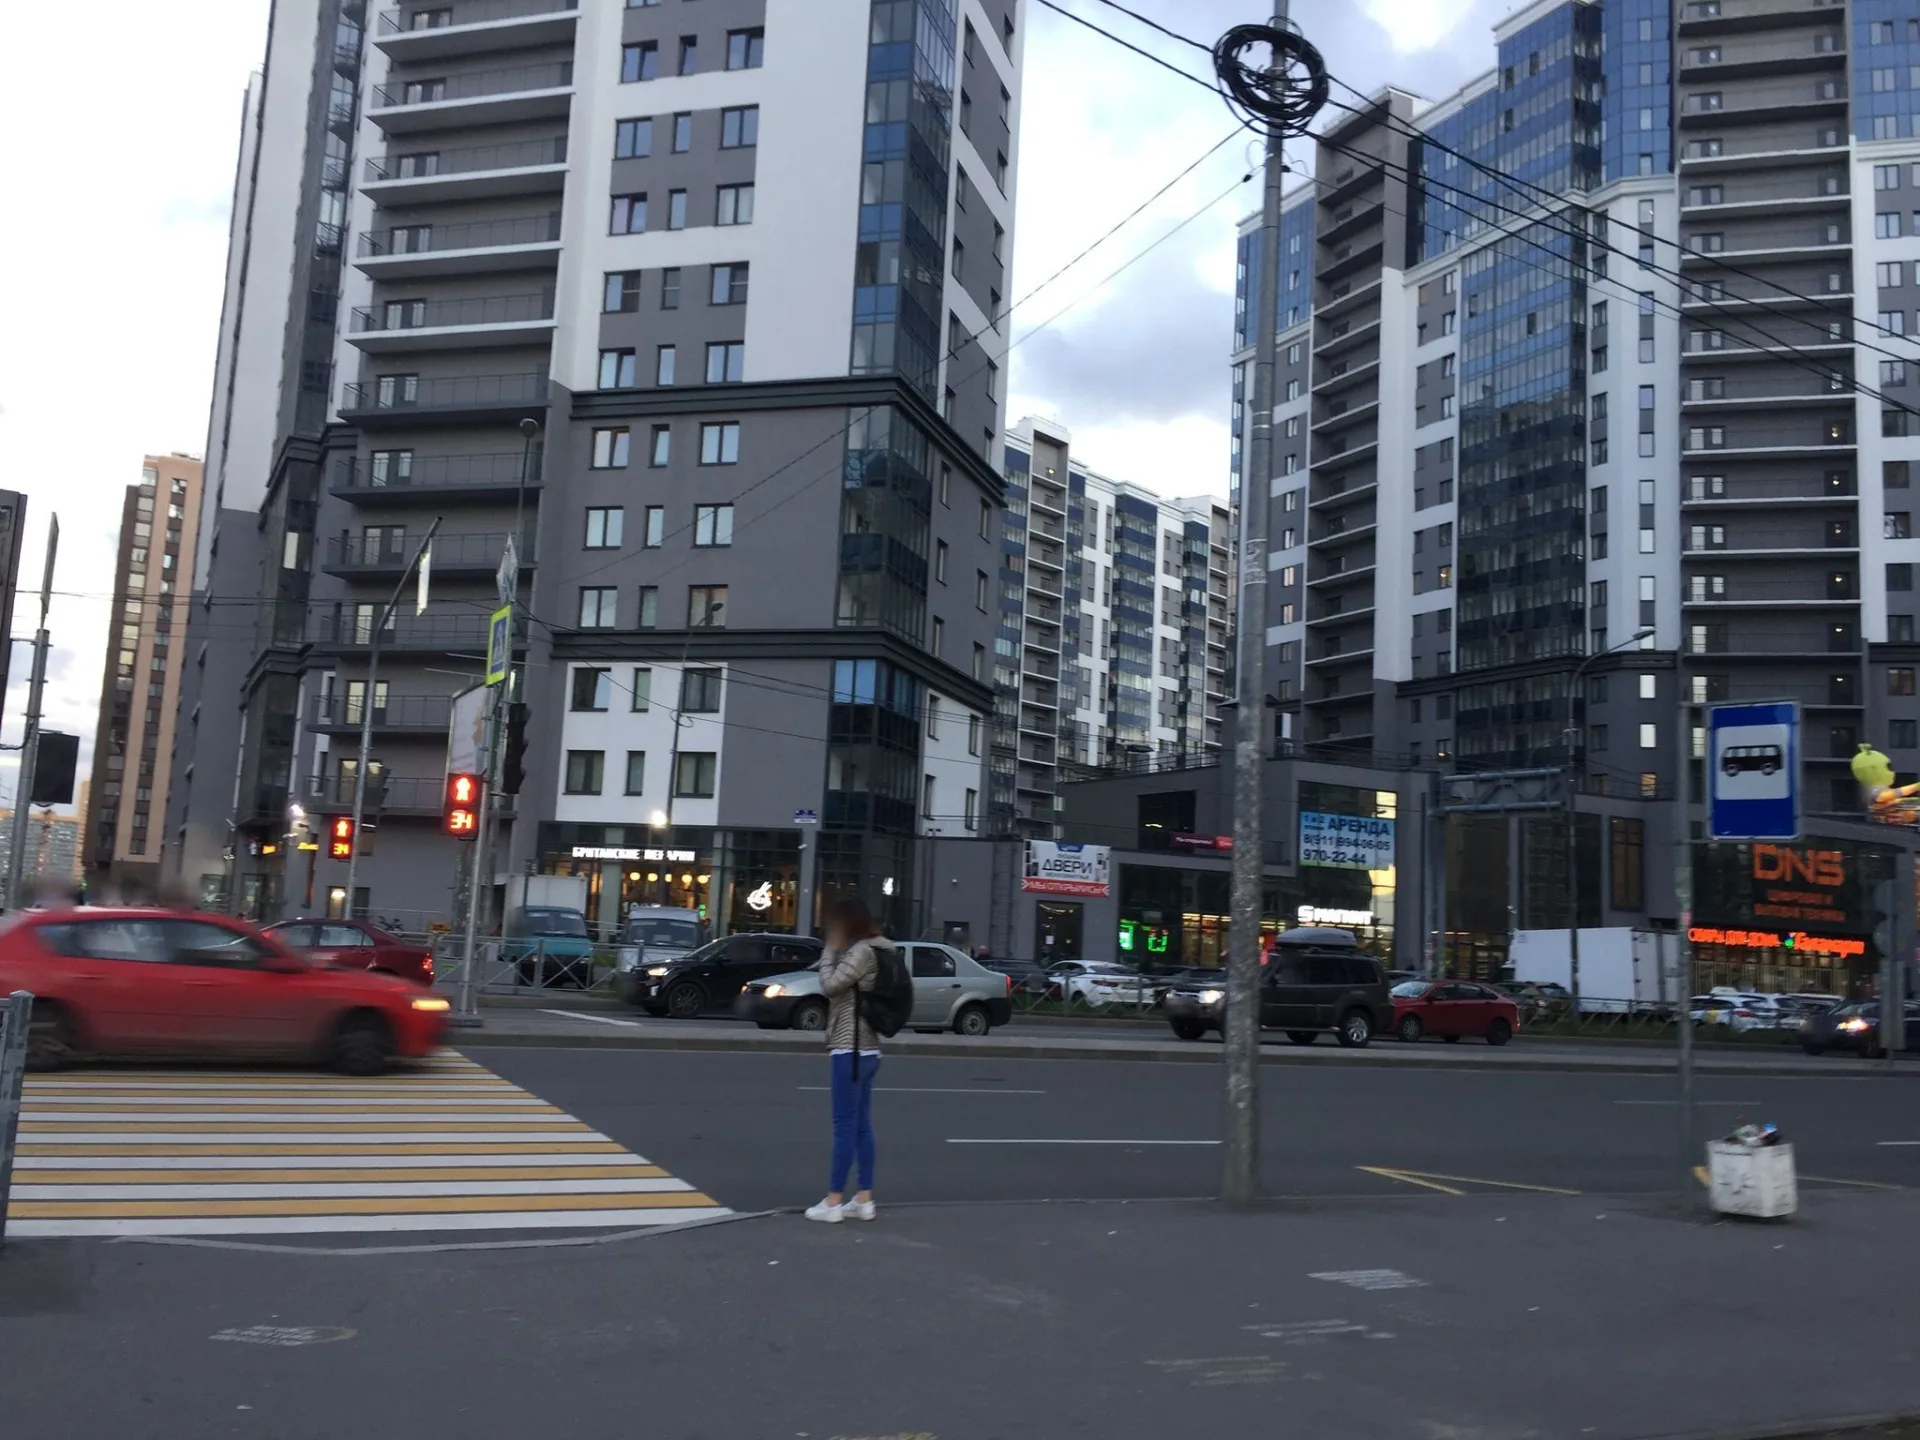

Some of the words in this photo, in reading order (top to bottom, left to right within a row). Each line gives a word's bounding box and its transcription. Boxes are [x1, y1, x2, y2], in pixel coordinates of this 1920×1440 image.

[451, 811, 473, 829] 34
[1327, 817, 1390, 837] АРЕНДА
[333, 843, 349, 855] 34
[1303, 849, 1366, 864] 970-22-44
[1042, 859, 1092, 874] ДВЕРИ
[1753, 844, 1845, 886] DNS
